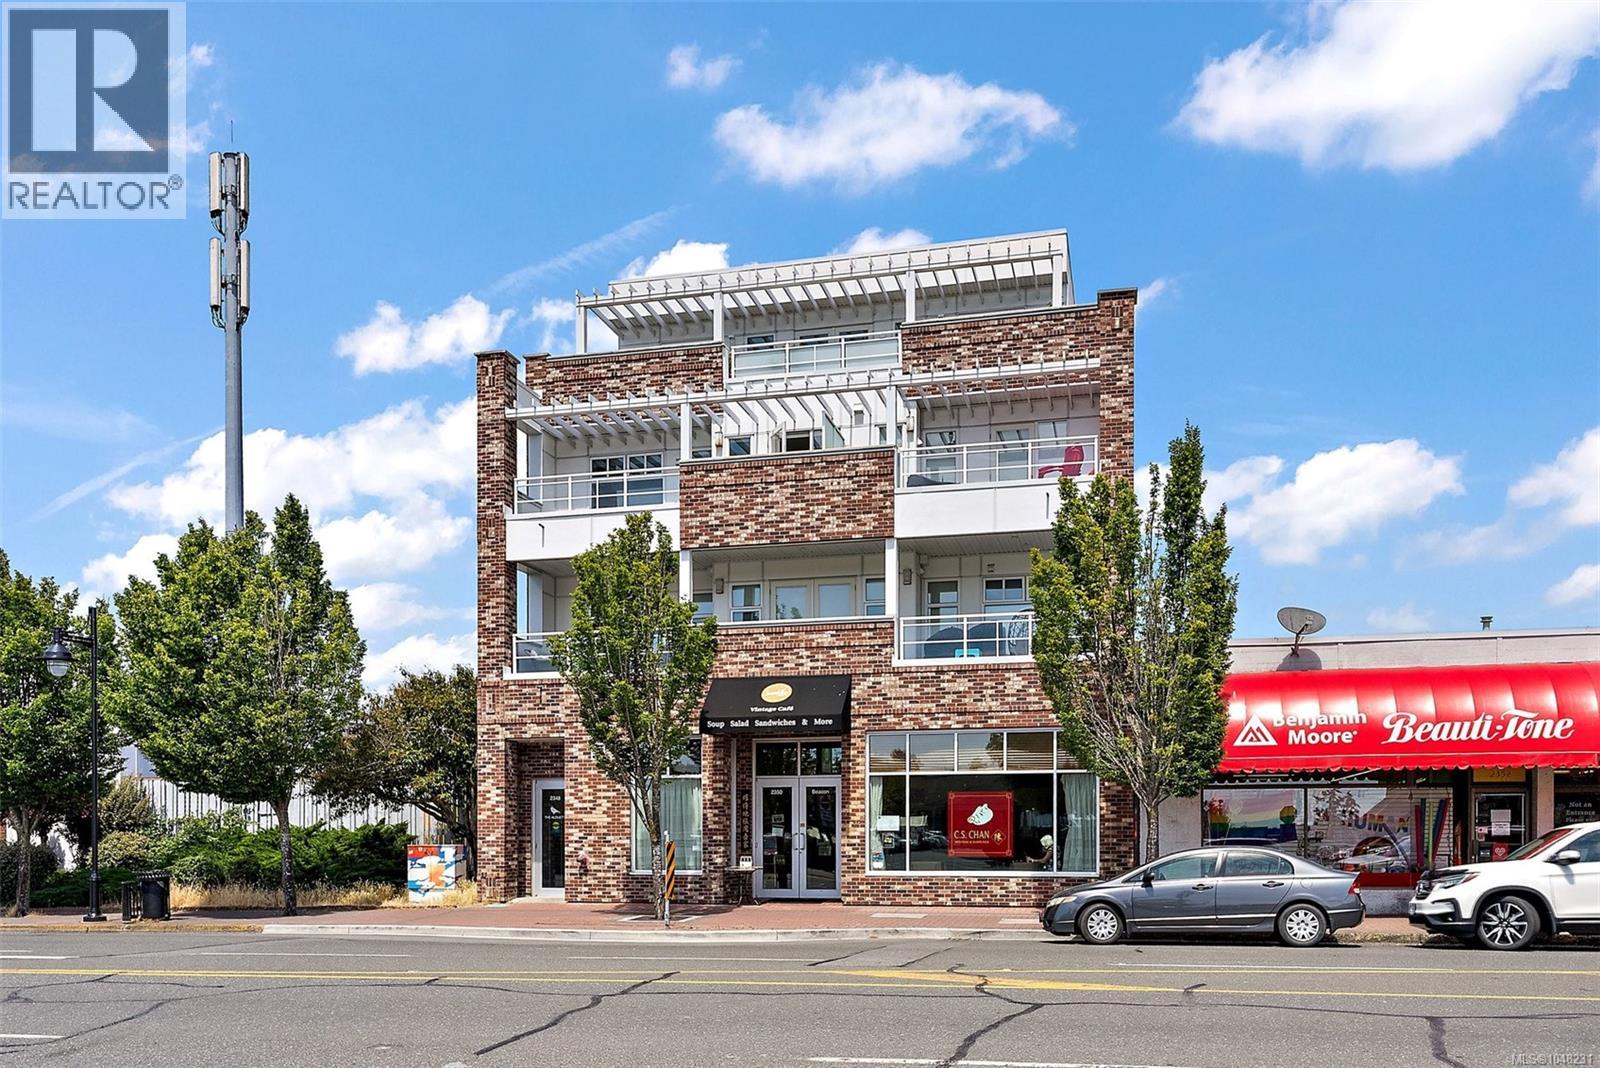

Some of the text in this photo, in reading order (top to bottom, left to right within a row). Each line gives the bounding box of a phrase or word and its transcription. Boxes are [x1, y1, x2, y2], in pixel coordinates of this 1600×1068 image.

[707, 718, 833, 729] Soup Salad Sandwiches & More
[1272, 711, 1368, 730] Benjamin
[968, 830, 990, 839] CHAN
